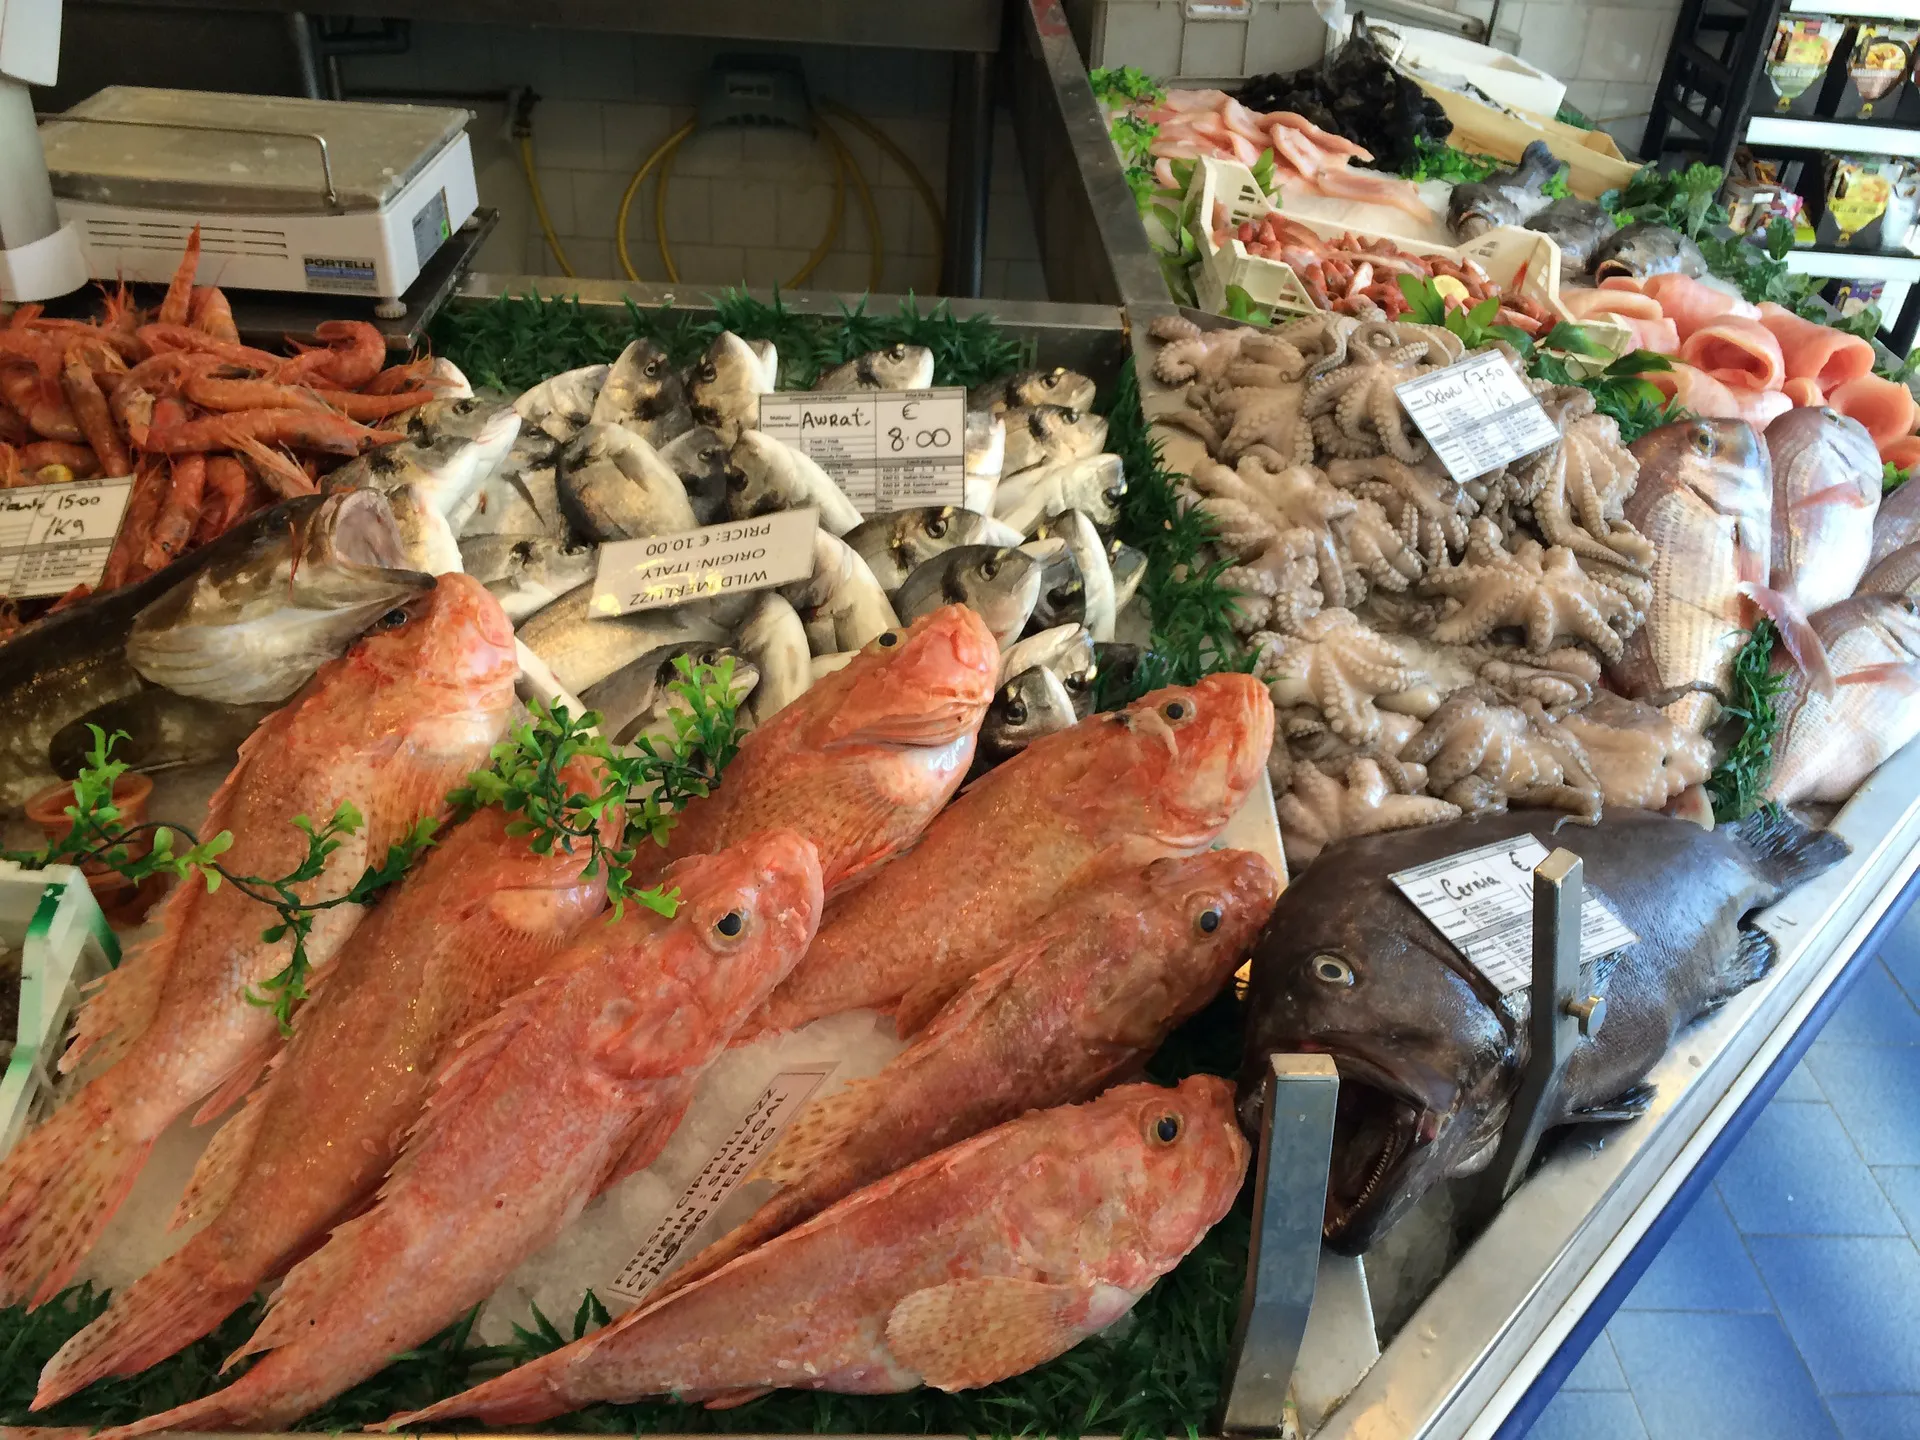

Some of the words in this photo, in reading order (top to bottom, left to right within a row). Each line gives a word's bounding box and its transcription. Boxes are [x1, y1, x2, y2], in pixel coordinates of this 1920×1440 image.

[304, 258, 375, 268] PORTELLI
[902, 403, 920, 420] €
[716, 523, 771, 543] PRICE:
[646, 537, 693, 556] 10.00
[696, 548, 766, 569] ORIGIN:
[641, 562, 689, 581] ITALY
[722, 570, 768, 588] WILD
[1508, 851, 1531, 872] €
[1440, 871, 1501, 900] Cernia
[708, 1092, 789, 1187] SENEGAL
[711, 1162, 748, 1202] PER
[748, 1126, 776, 1155] KG
[614, 1217, 673, 1285] FRESH
[676, 1088, 778, 1210] CIPPULLAZZ
